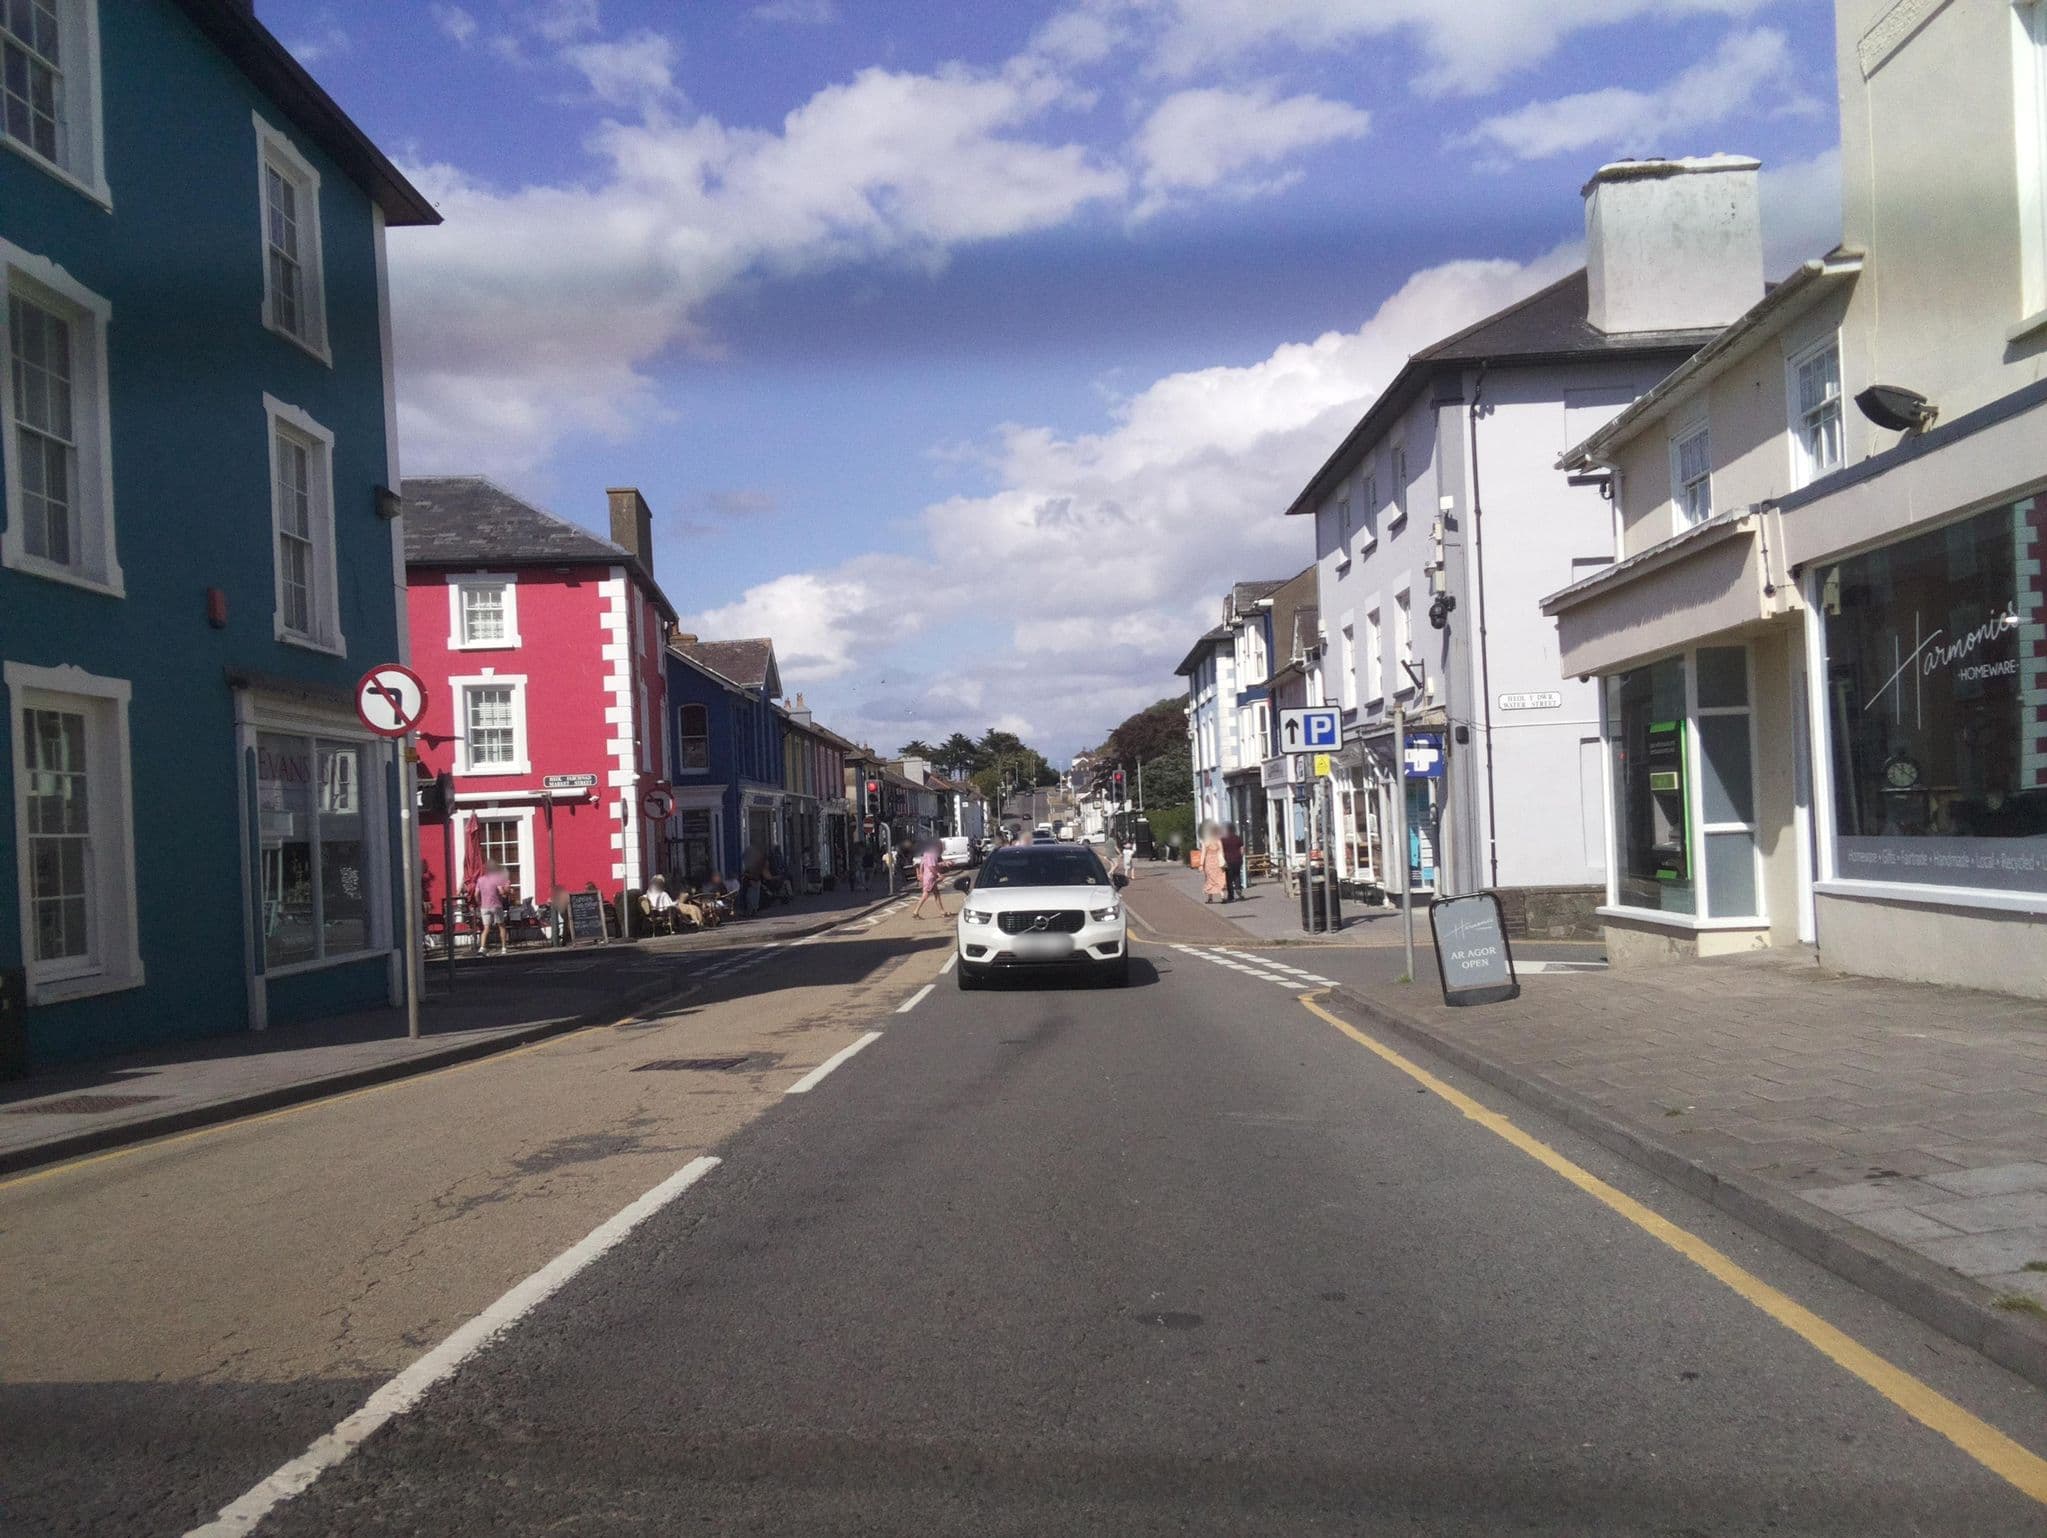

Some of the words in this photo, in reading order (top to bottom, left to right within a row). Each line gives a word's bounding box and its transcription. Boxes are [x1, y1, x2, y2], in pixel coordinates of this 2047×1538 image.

[1960, 659, 2016, 681] HOMEWARE
[1310, 716, 1332, 744] P
[258, 747, 311, 784] EVANS
[1451, 951, 1465, 960] AR
[1467, 946, 1497, 958] AGOR
[1461, 959, 1489, 969] OPEN
